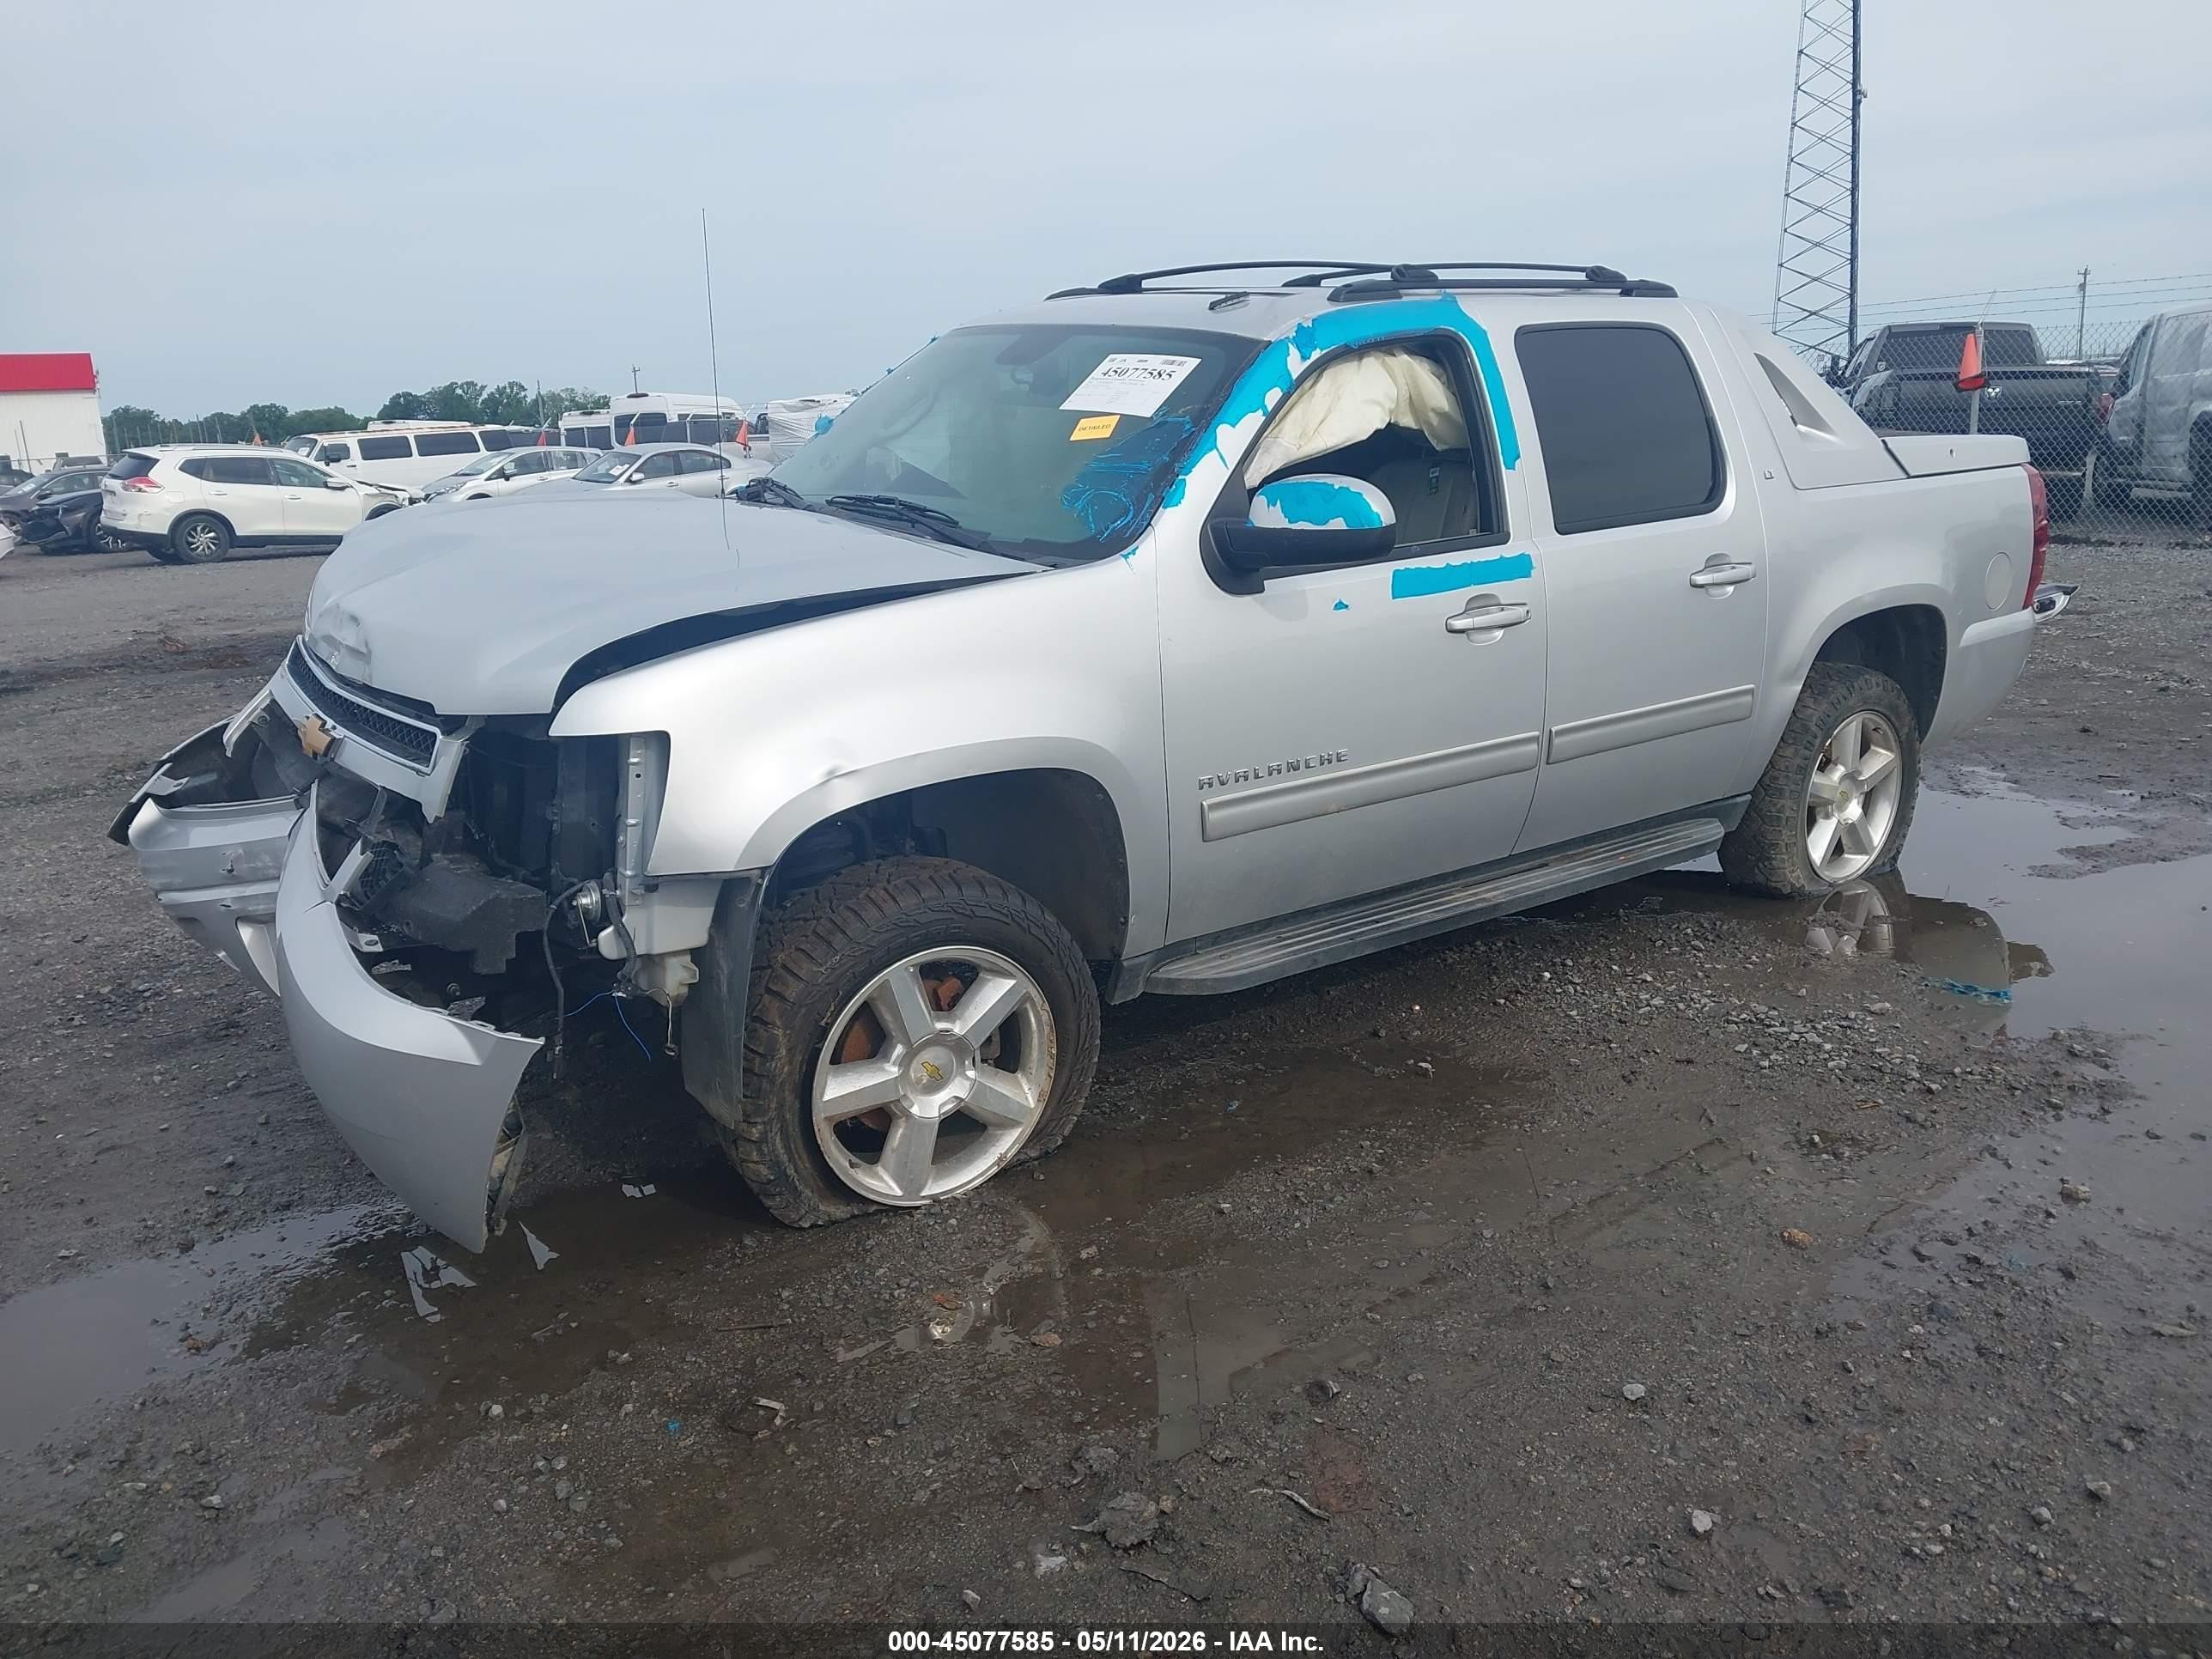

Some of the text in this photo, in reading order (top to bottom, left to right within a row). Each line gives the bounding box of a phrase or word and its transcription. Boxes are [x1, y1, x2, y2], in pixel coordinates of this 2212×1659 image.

[1101, 367, 1177, 380] 45077585
[1078, 423, 1112, 432] DETAILED
[1198, 748, 1350, 790] AVALANCHE
